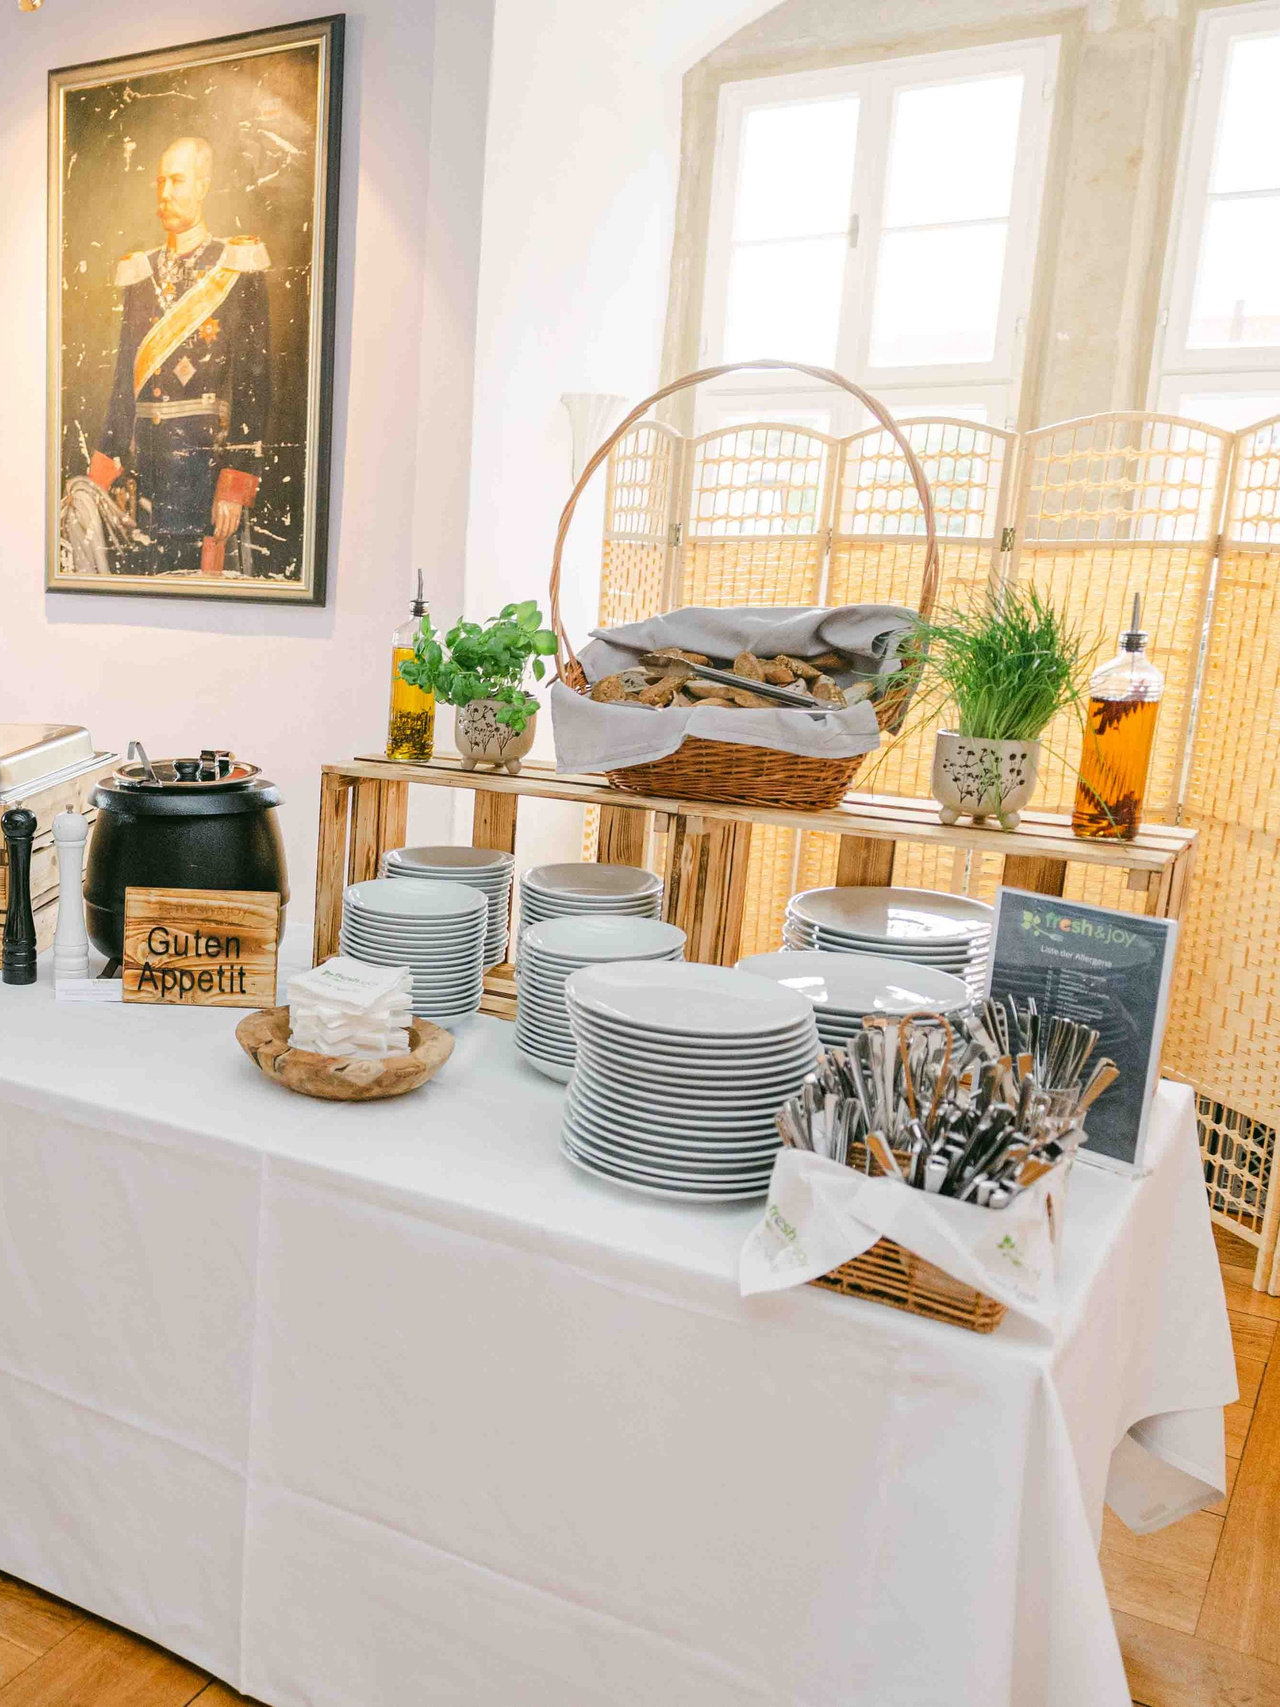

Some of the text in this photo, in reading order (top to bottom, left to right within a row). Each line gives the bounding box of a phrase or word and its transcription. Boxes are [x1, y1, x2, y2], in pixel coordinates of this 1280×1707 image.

[147, 926, 240, 959] Guten
[1040, 944, 1060, 956] Liste
[1060, 948, 1074, 959] der
[137, 961, 247, 999] Appetit
